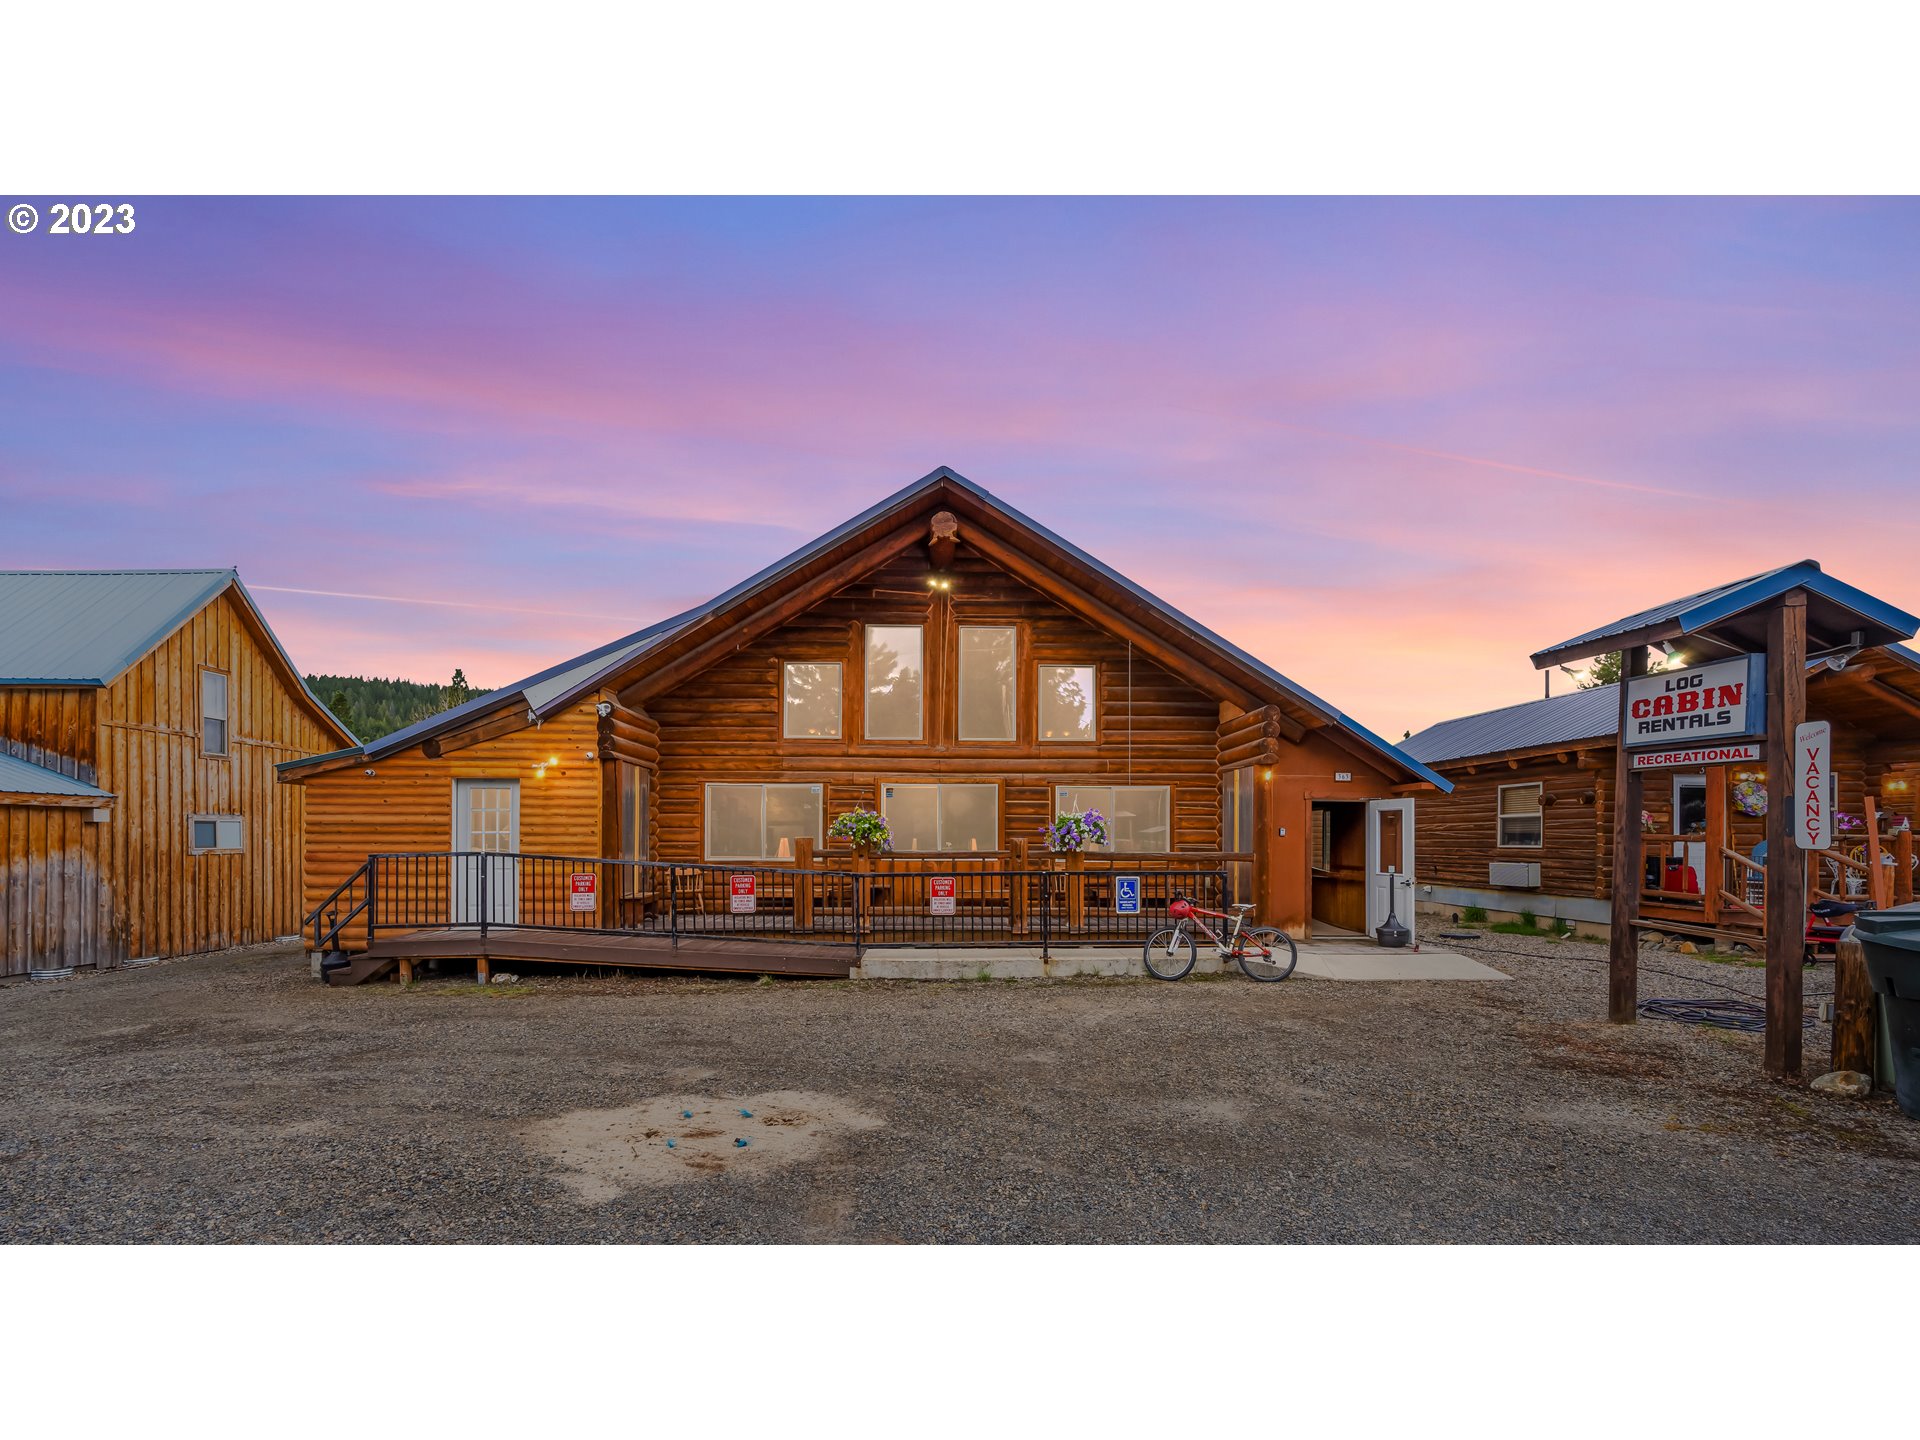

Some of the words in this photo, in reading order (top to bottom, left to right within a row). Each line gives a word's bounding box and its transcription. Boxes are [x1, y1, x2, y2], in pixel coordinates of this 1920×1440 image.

[1665, 674, 1703, 692] LOG
[1632, 683, 1744, 719] CABIN
[1638, 710, 1731, 734] RENTALS
[1800, 728, 1826, 742] Welcome
[1637, 748, 1754, 765] RECREATIONAL
[1806, 747, 1820, 845] VACANCY
